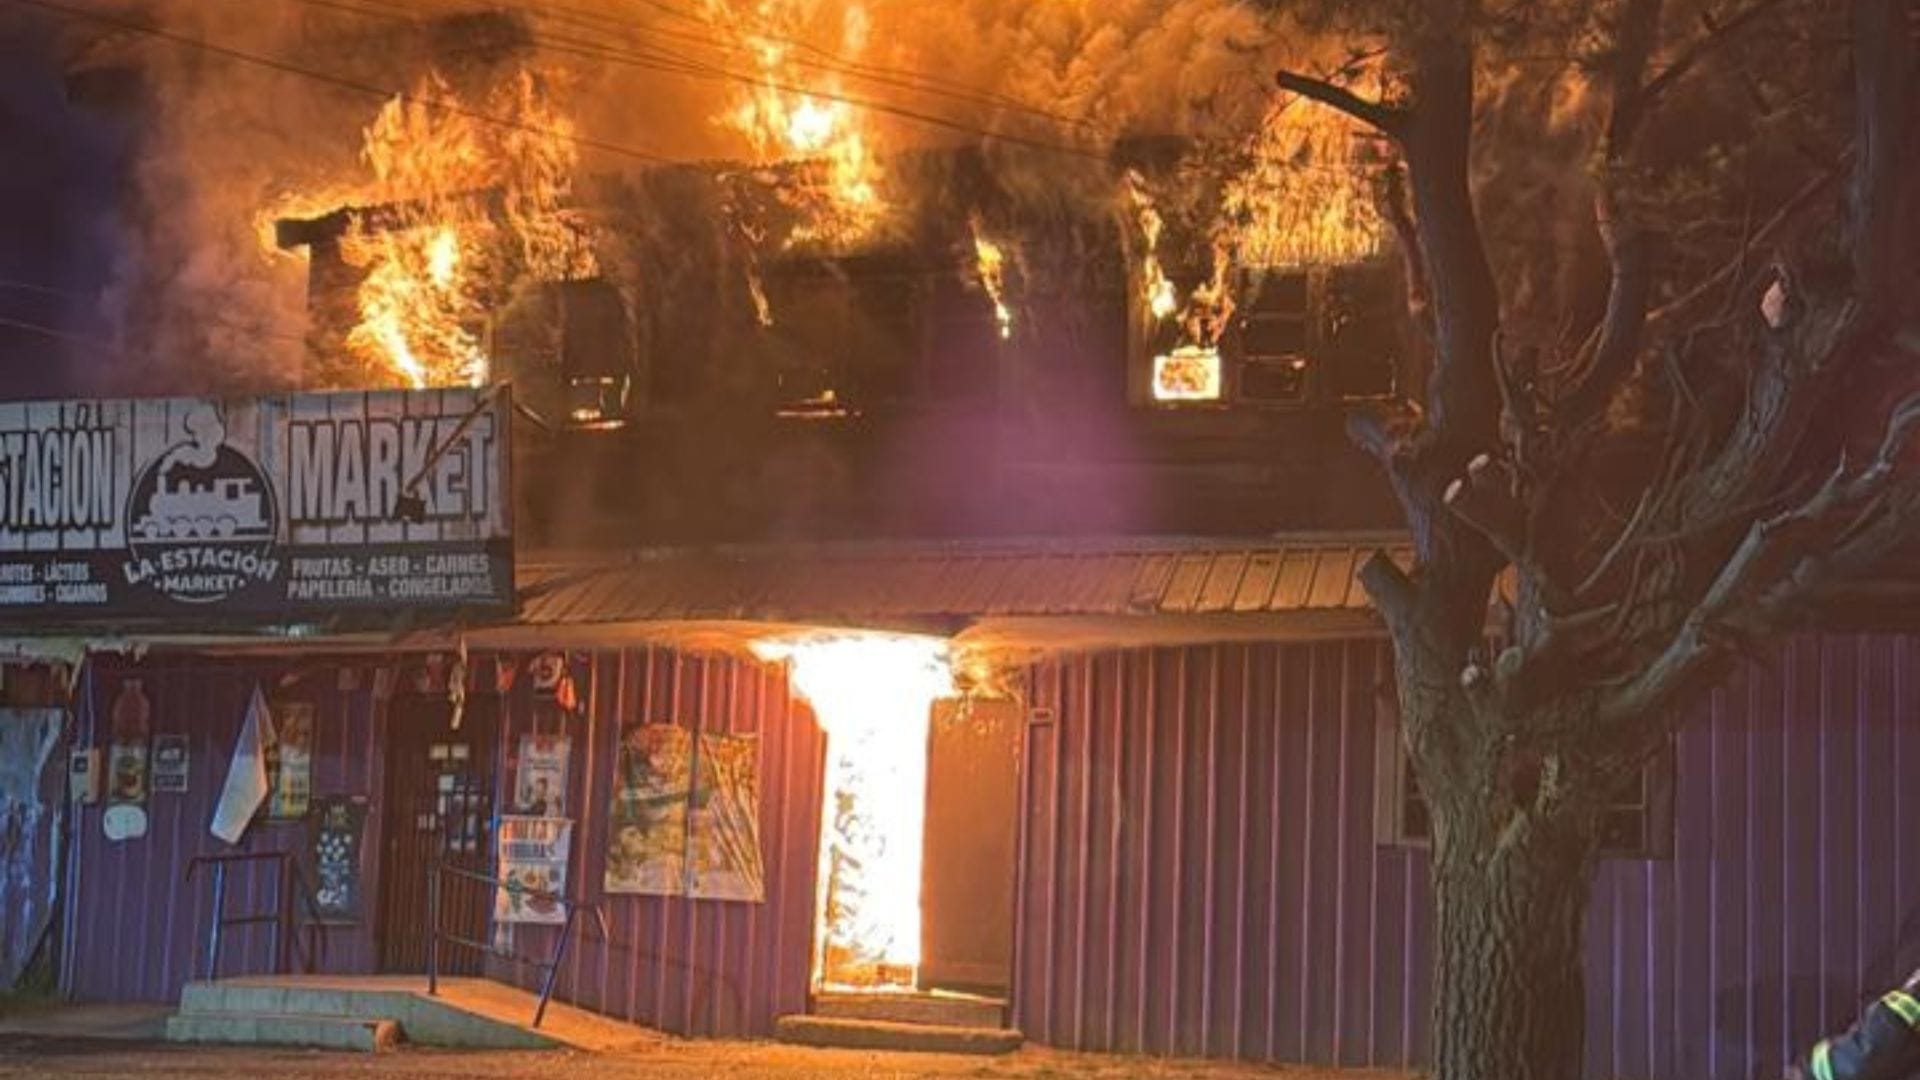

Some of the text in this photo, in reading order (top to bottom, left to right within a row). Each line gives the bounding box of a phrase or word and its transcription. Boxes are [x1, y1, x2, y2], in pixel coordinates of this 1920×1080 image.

[289, 415, 493, 523] MARKET
[123, 547, 279, 584] LA ESTACIÓN
[292, 554, 489, 577] FRUTAS ASEO CARNES
[163, 574, 237, 593] MARKET
